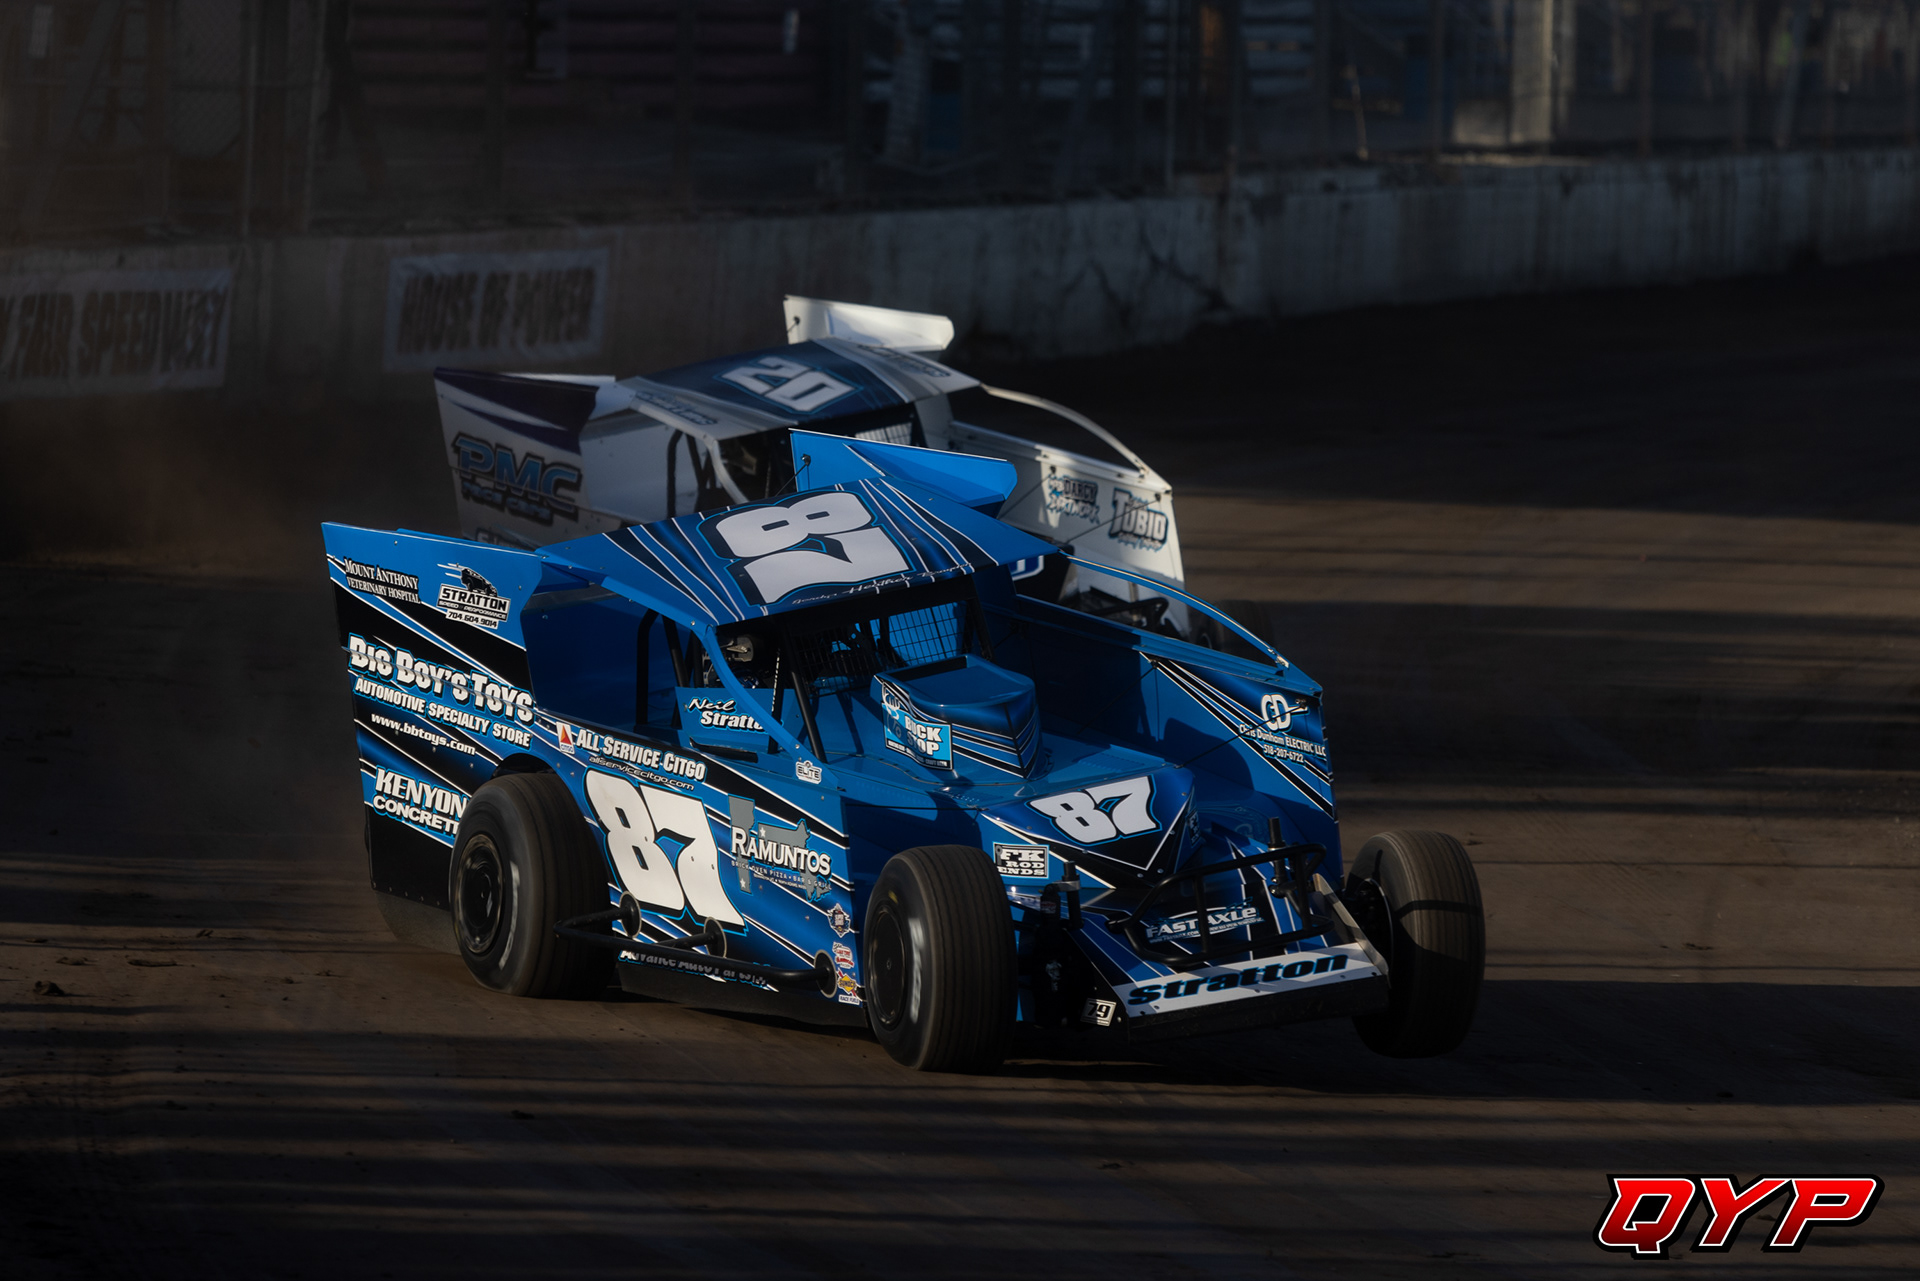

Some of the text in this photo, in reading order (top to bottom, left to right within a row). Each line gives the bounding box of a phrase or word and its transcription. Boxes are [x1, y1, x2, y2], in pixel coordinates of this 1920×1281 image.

[720, 355, 857, 413] 20
[453, 434, 581, 517] PMC
[716, 491, 911, 604] 87
[344, 558, 419, 590] MOUNT ANTHONY
[346, 576, 421, 604] VETERINARY HOSPITAL
[442, 588, 508, 612] STRATTON
[355, 677, 533, 748] AUTOMOTIVE SPECIALTY STORE
[471, 671, 535, 724] TOYS
[688, 697, 737, 713] Neil
[370, 713, 476, 756] www.bbtoys.com
[904, 715, 943, 742] BUCK
[906, 731, 940, 756] STOP
[576, 729, 707, 782] ALL SERVICE CITGO
[1285, 736, 1314, 753] ELECTRIC
[1314, 744, 1326, 757] LLC
[797, 765, 820, 779] ELITE
[375, 767, 471, 819] KENYON
[1028, 775, 1159, 844] 87
[586, 770, 745, 928] 87
[731, 826, 832, 876] RAMUNTOS
[1000, 848, 1044, 862] FK
[1005, 860, 1045, 869] ROD
[997, 866, 1045, 876] ENDS
[1146, 918, 1199, 938] FAST
[1127, 954, 1349, 1006] stratton
[1087, 1002, 1111, 1019] 79
